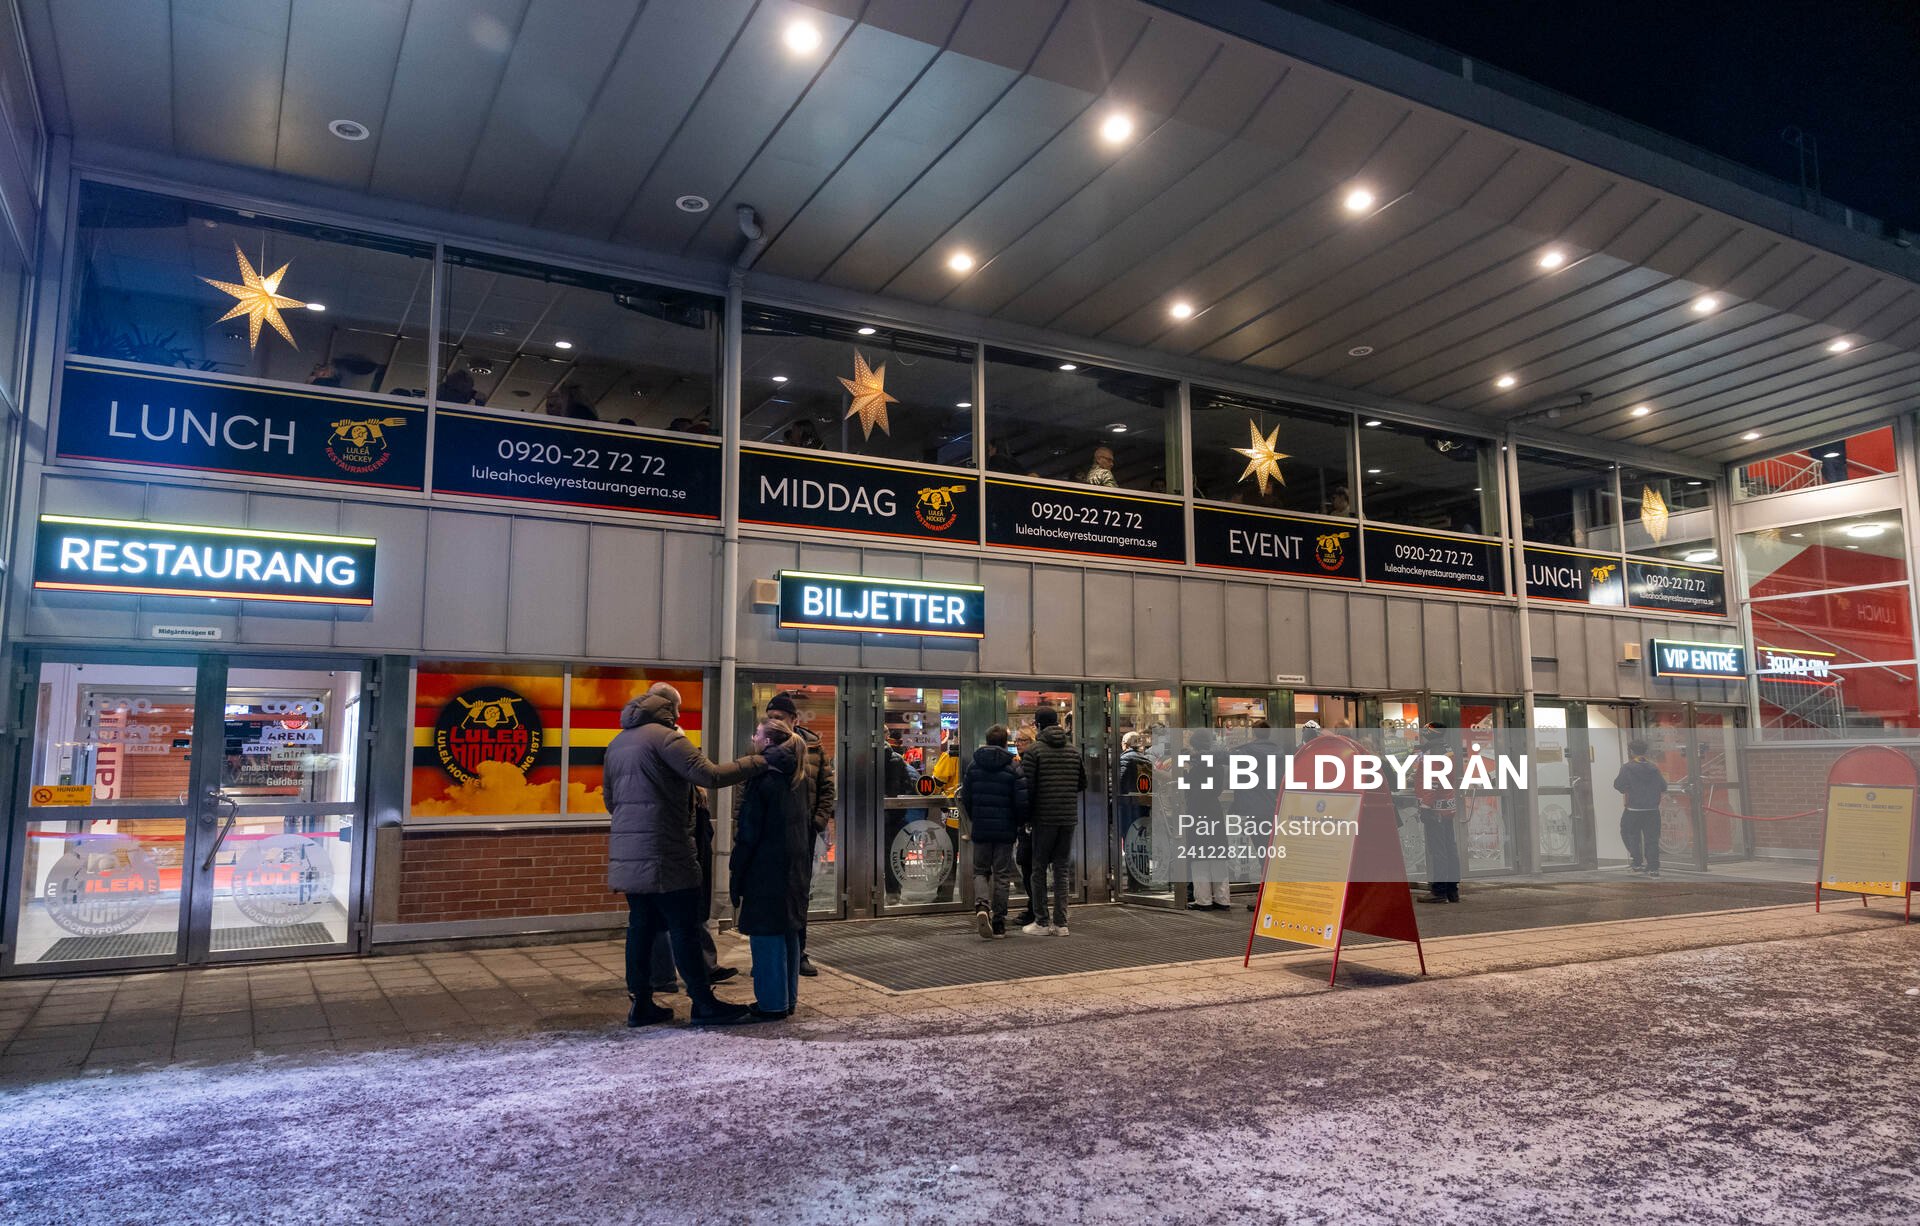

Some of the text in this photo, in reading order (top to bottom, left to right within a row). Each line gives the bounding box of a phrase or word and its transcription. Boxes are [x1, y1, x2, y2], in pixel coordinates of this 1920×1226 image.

[108, 401, 296, 455] LUNCH
[342, 454, 372, 463] HOCKEY
[346, 446, 370, 455] LULEÅ
[498, 439, 666, 476] 0920-22 72 72
[471, 465, 687, 499] luleahockeyrestaurangerna.se
[760, 475, 897, 517] MIDDAG
[1031, 501, 1143, 529] 0920-22 72 72
[1015, 523, 1158, 548] luleahockeyrestaurangerna.se
[1229, 529, 1304, 560] EVENT
[60, 537, 356, 586] RESTAURANG
[1395, 544, 1474, 567] 0920-22 72 72
[1384, 562, 1485, 582] luleahockeyrestaurangerna.se
[1646, 574, 1706, 592] 0920-22 72 72
[803, 585, 966, 625] BILJETTER
[1664, 648, 1738, 672] VIP ENTRÉ
[268, 731, 317, 741] ARENA
[450, 724, 528, 743] LULEÅ
[437, 730, 450, 764] LULEÅ
[531, 731, 541, 753] 1977
[920, 779, 932, 792] IN
[1139, 778, 1149, 790] IN
